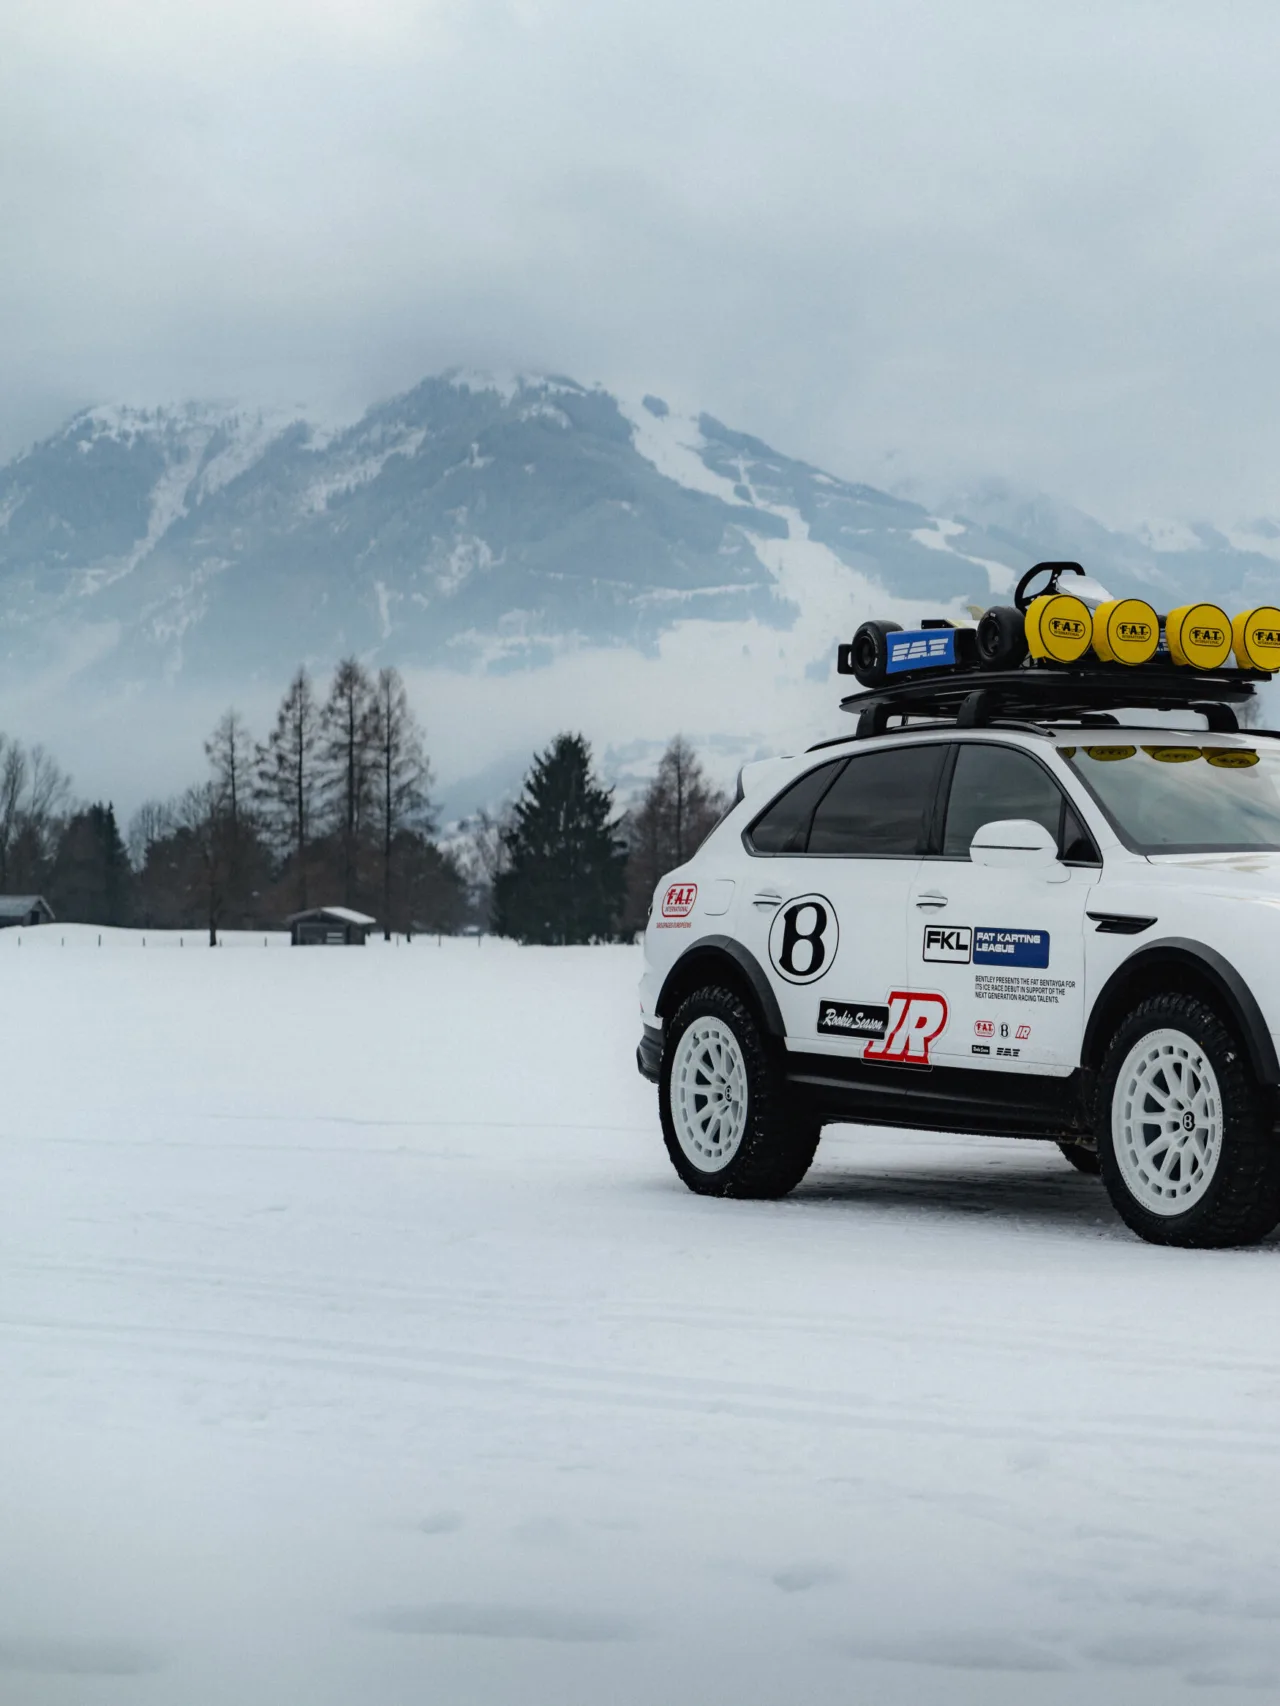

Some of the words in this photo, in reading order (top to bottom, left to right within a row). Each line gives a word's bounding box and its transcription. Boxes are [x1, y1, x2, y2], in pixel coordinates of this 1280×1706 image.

[926, 931, 968, 951] FKL
[976, 932, 995, 941] FAT
[997, 933, 1040, 944] KARTING
[976, 943, 1015, 953] LEAGUE
[975, 975, 995, 983] BENTLEY
[995, 976, 1020, 985] PRESENTS
[1039, 979, 1065, 987] BENTAYGA
[1065, 980, 1075, 988] FOR
[991, 984, 1003, 992] RACE
[1004, 985, 1019, 993] DEBUT
[1026, 986, 1048, 994] SUPPORT
[1048, 987, 1055, 995] OF
[975, 991, 987, 999] NEXT
[988, 992, 1017, 1001] GENERATION
[1018, 994, 1036, 1002] RACING
[1037, 995, 1059, 1004] TALENTS.
[823, 1008, 853, 1027] Rookie
[851, 1012, 884, 1031] Season
